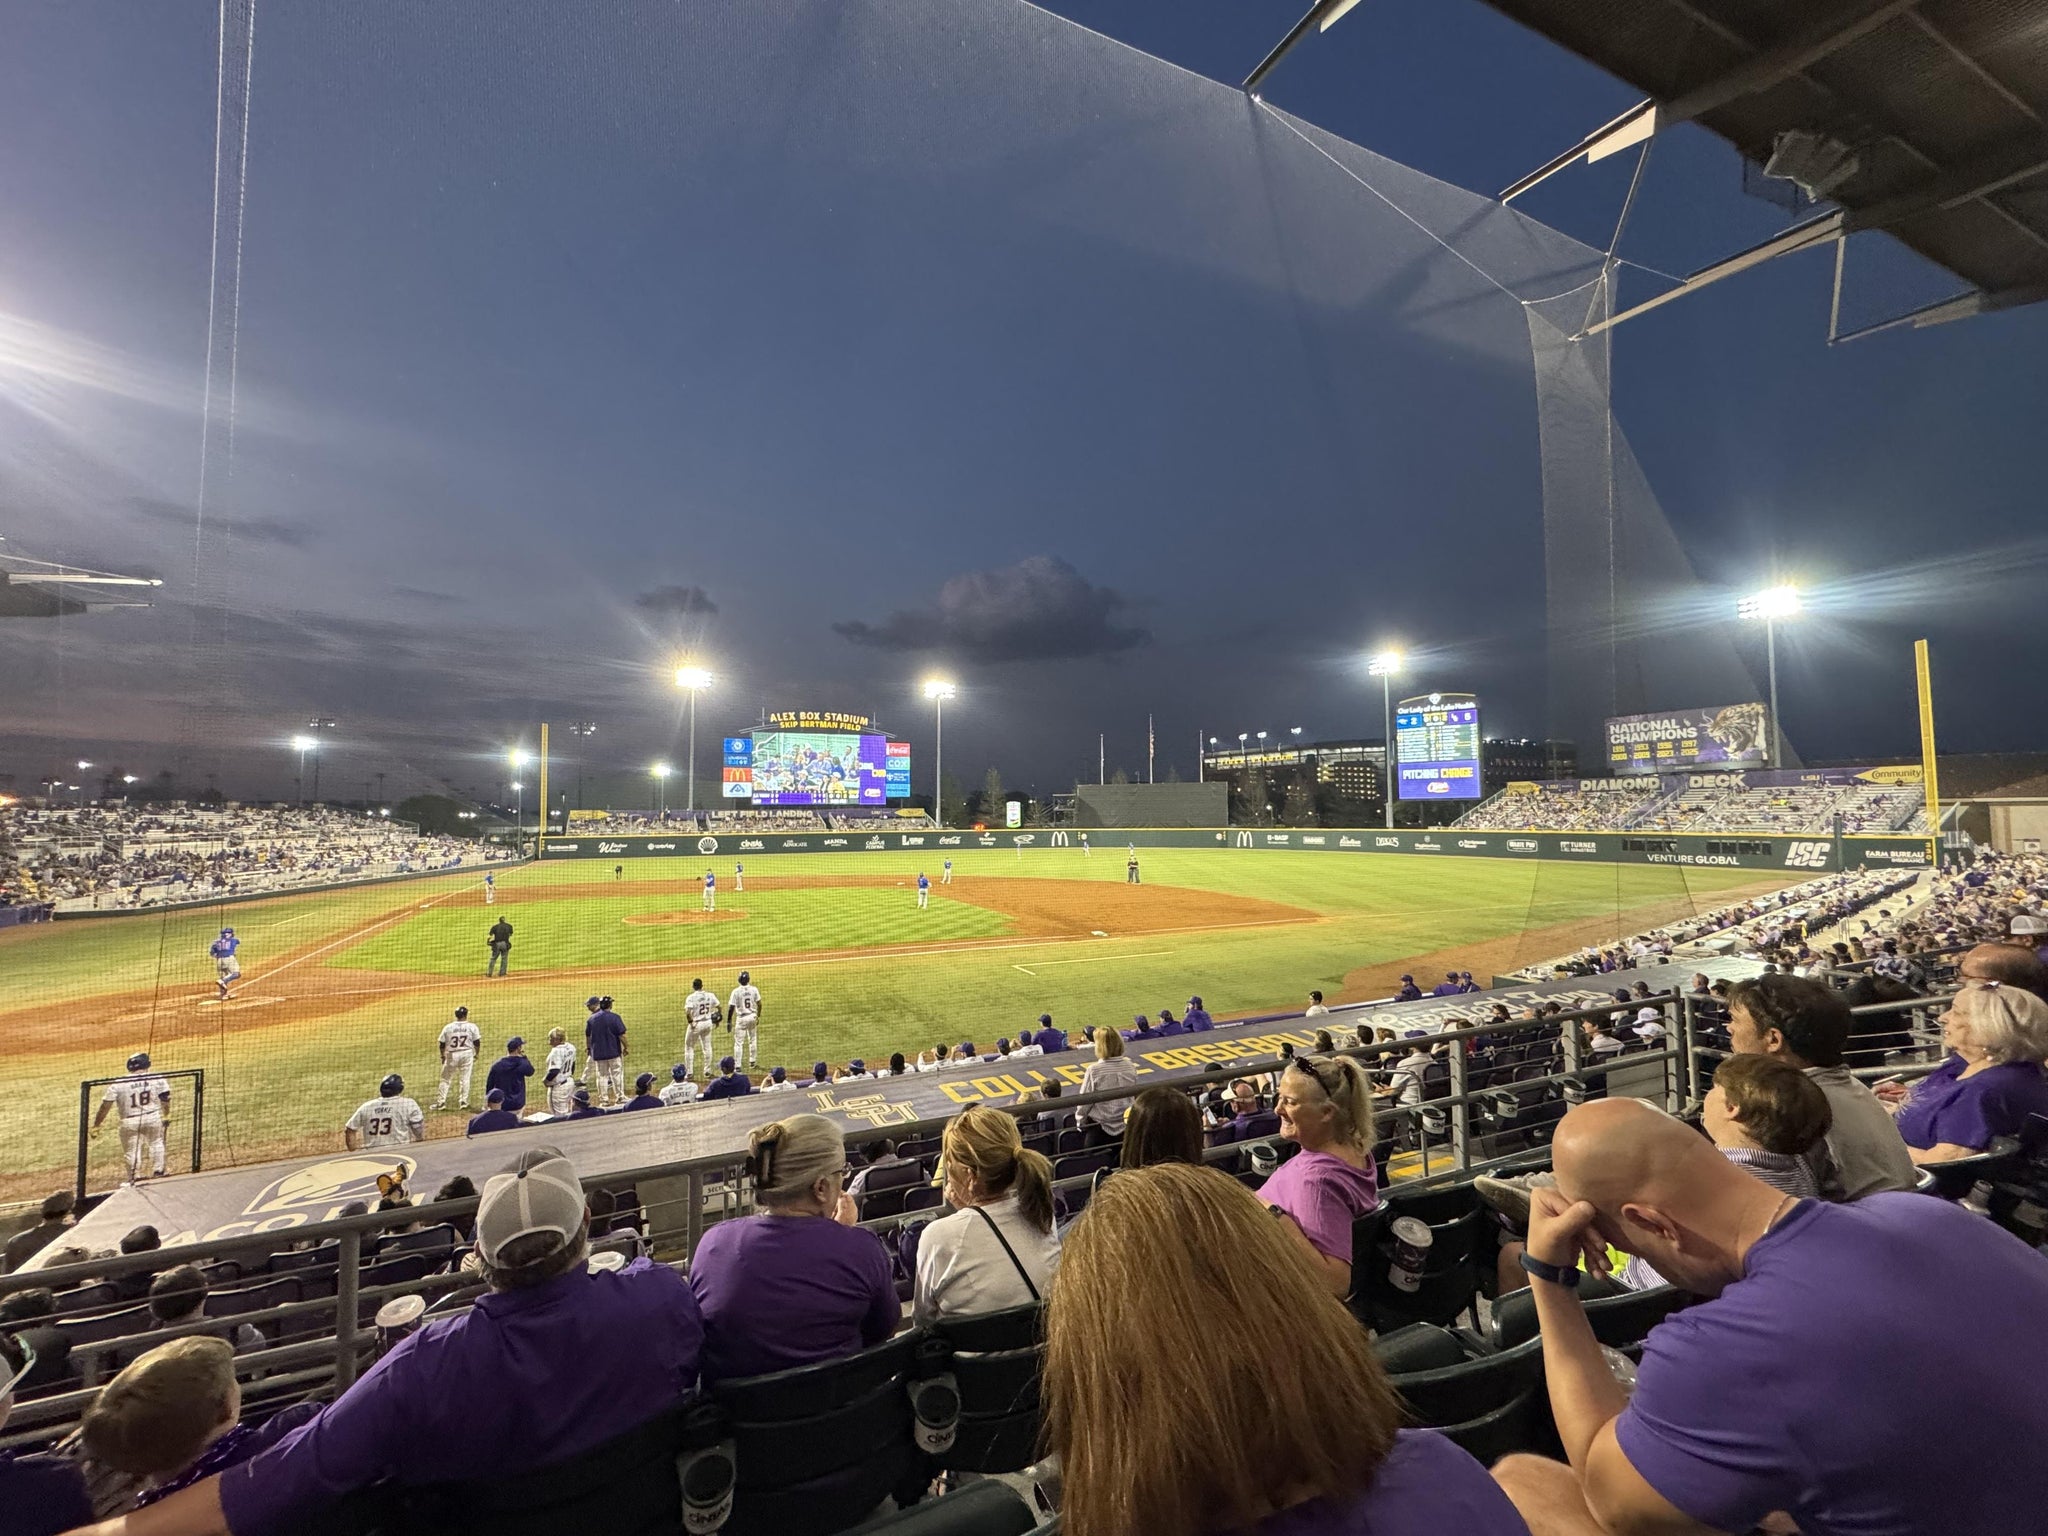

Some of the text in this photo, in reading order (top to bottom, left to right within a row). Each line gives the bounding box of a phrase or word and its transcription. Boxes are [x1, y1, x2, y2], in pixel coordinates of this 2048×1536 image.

[770, 711, 869, 726] ALEX BOX STADIUM
[780, 720, 861, 732] SKIP BERTMAN FIELD
[1609, 718, 1680, 735] NATIONAL
[1610, 726, 1698, 744] CHAMPIONS
[888, 759, 908, 769] COX
[1402, 769, 1439, 779] PITCHING
[1871, 769, 1921, 780] Community
[1580, 773, 1747, 791] DIAMOND DECK
[712, 810, 813, 818] LEFT FIELD LANDING
[1647, 854, 1740, 866] VENTURE GLOBAL
[1785, 842, 1831, 867] ISC
[1865, 850, 1925, 858] FARM BUREAU
[699, 1003, 710, 1015] 25
[744, 998, 751, 1009] 6
[450, 1035, 468, 1048] 37
[806, 1089, 920, 1128] LSU
[938, 1060, 1154, 1104] COLLE
[1139, 1024, 1359, 1070] BASEBALS
[130, 1091, 151, 1108] 18
[369, 1117, 392, 1136] 33
